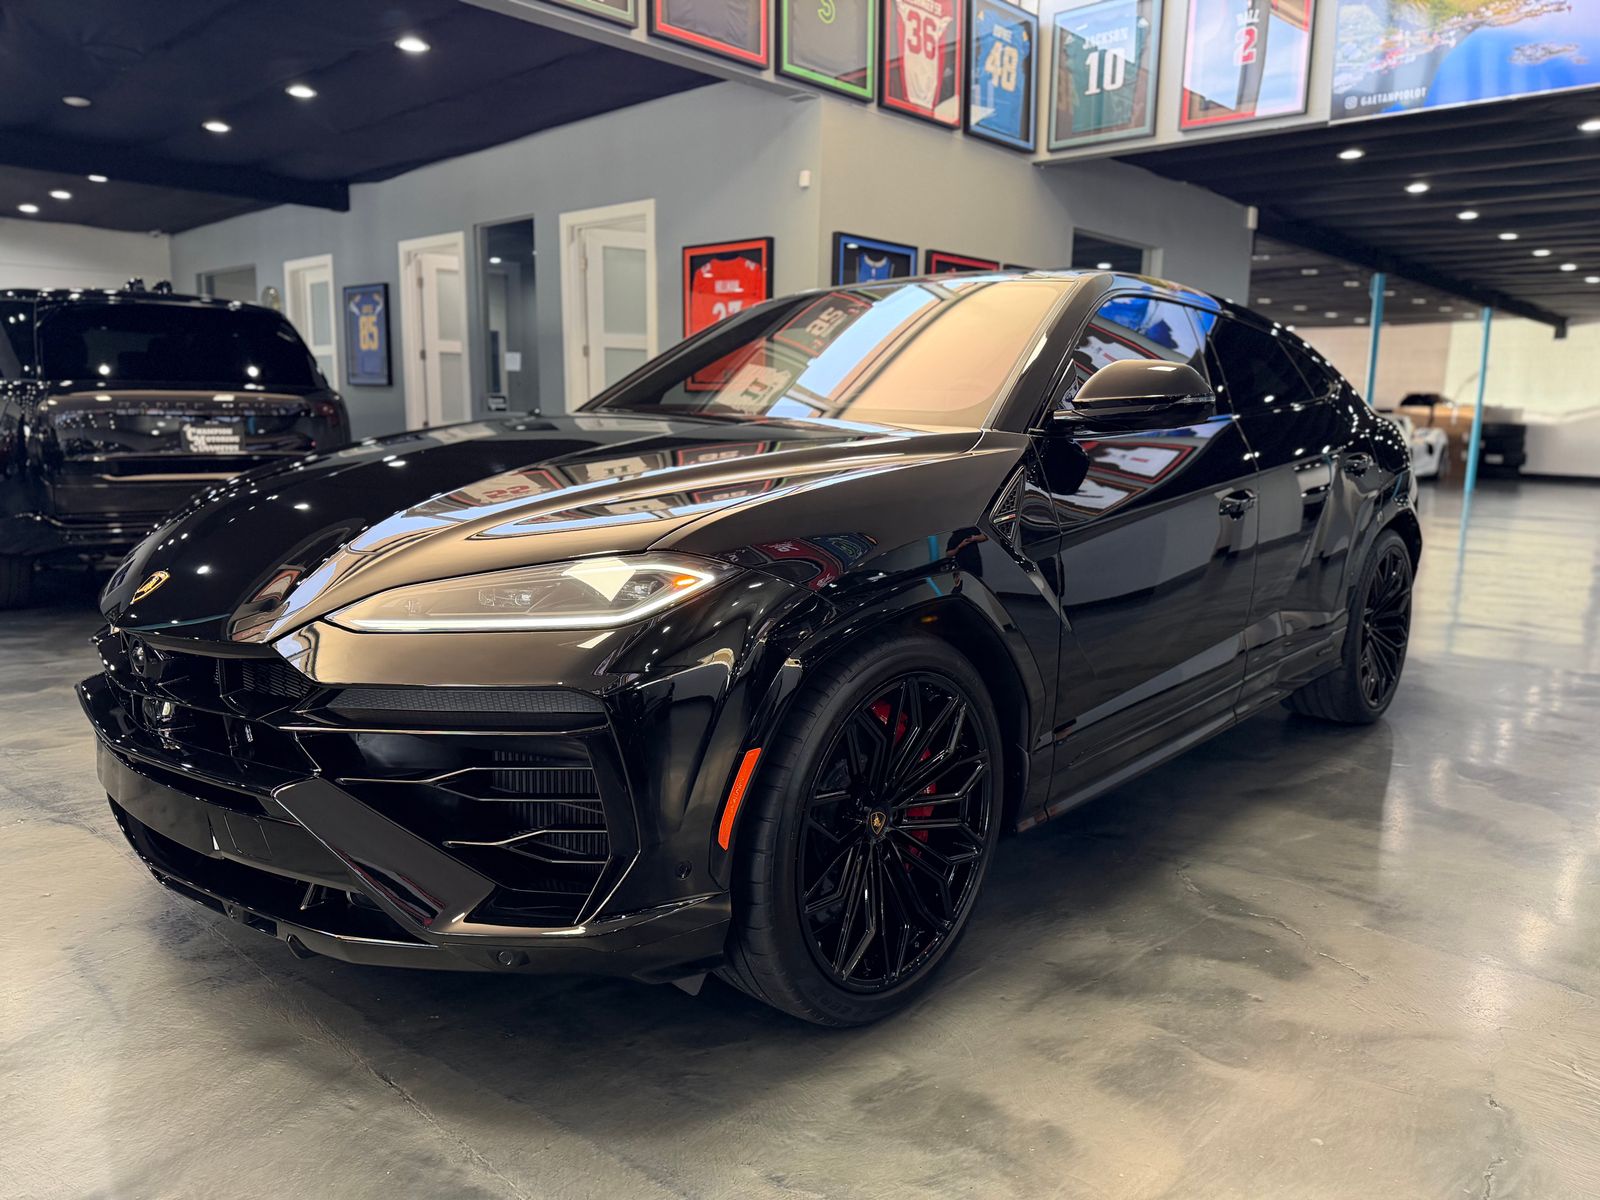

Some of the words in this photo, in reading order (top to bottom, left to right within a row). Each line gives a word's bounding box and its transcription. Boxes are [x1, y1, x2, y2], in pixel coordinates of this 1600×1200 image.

[906, 9, 937, 60] 36
[1233, 26, 1258, 66] 2
[984, 41, 1019, 92] 48
[1083, 48, 1126, 96] 10
